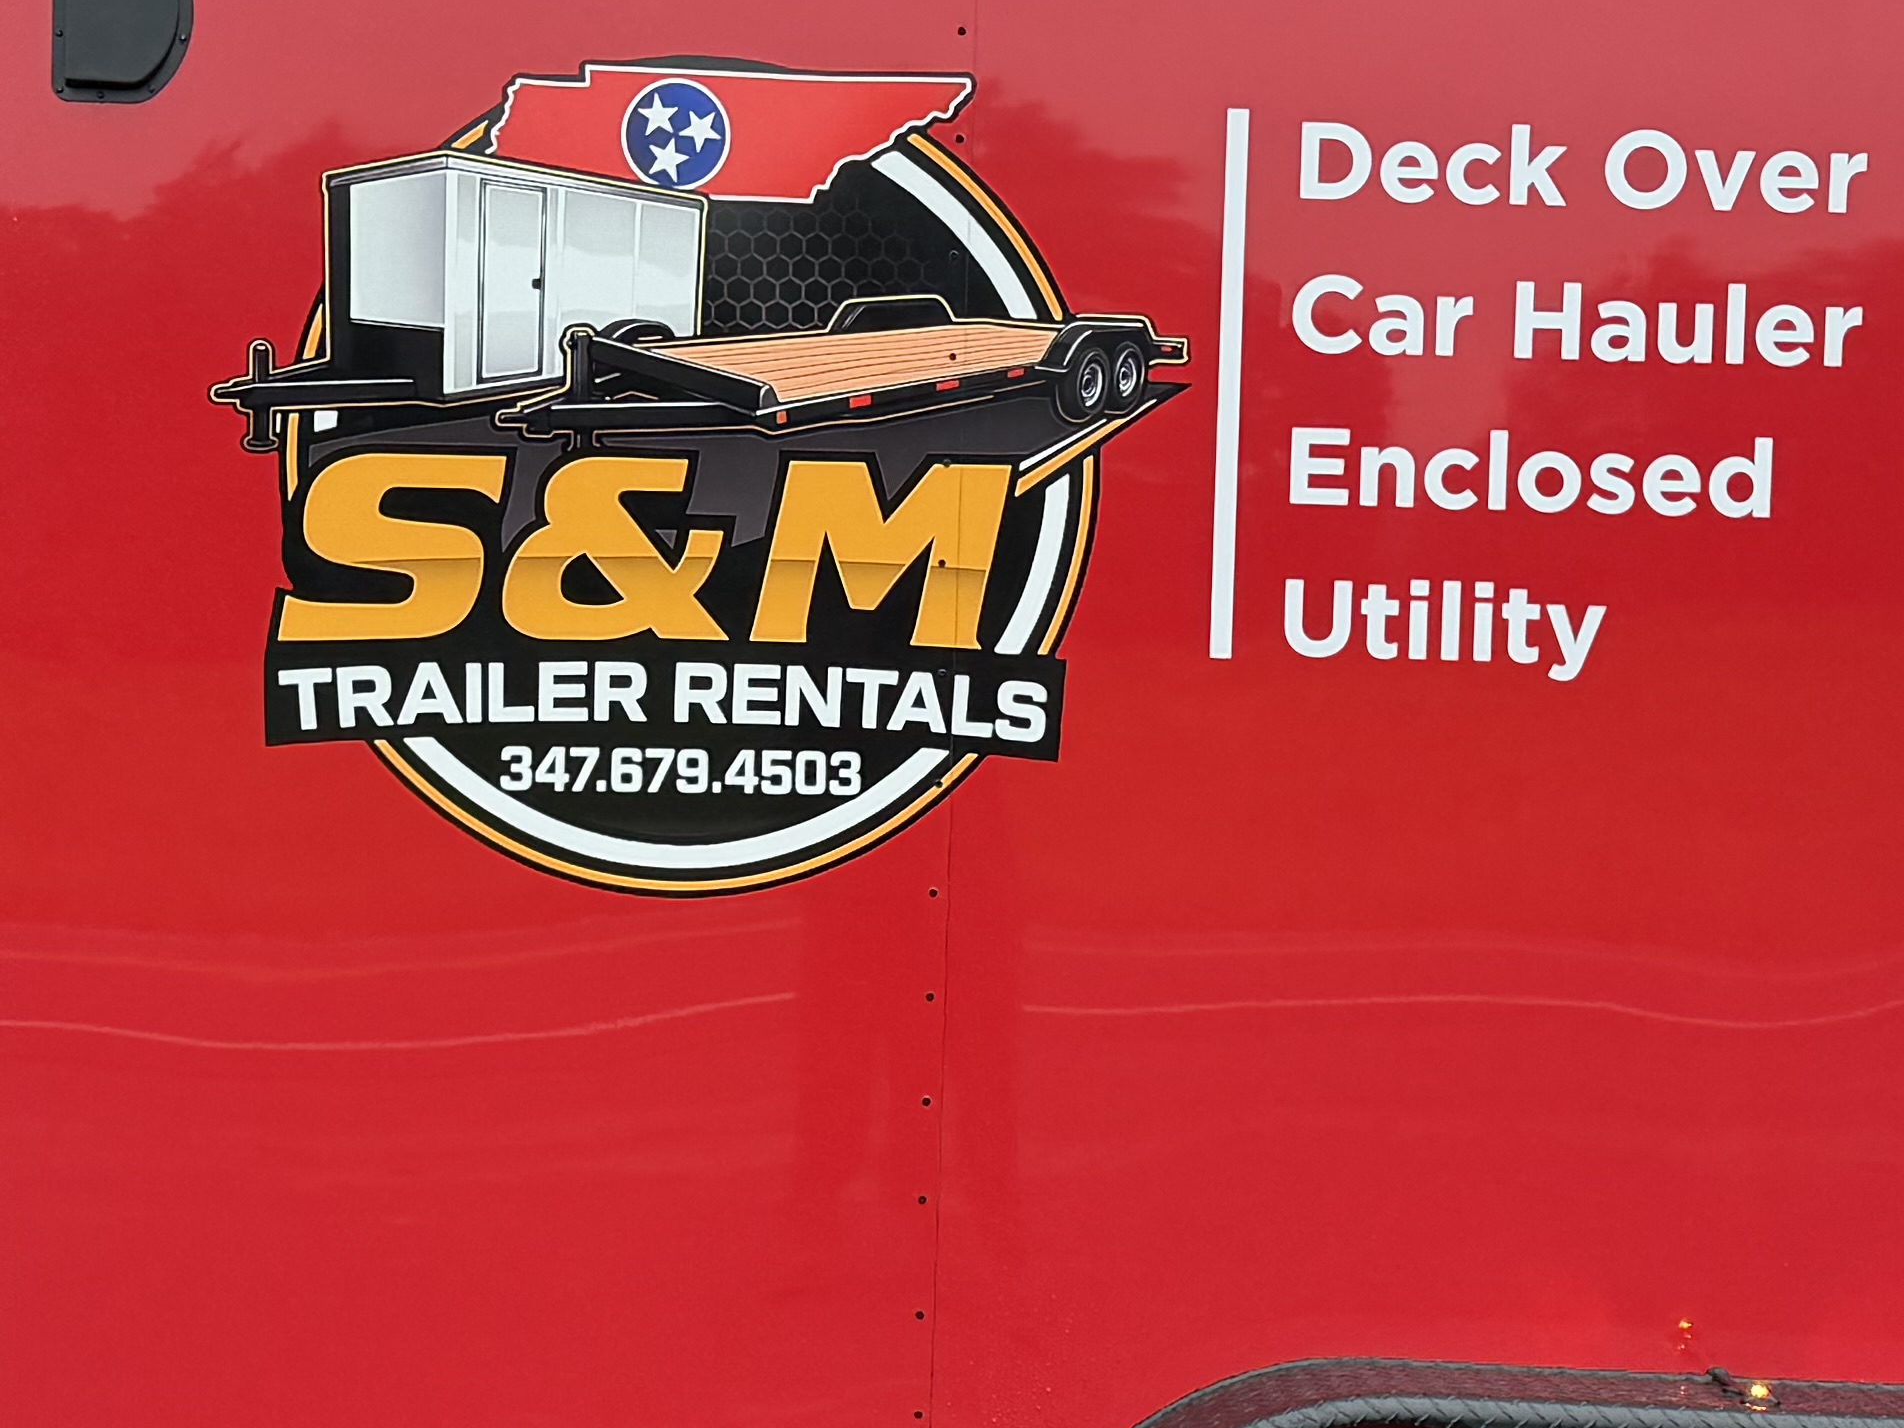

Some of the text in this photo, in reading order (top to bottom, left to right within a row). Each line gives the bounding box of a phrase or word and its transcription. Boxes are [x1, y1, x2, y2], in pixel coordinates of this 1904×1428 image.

[1299, 121, 1869, 214] Deck Over
[1292, 274, 1863, 367] Car Hauler
[1289, 427, 1774, 519] Enclosed
[278, 453, 1012, 649] S&M
[1284, 578, 1607, 682] Utility
[278, 660, 1047, 744] TRAILER RENTALS
[499, 745, 862, 798] 347.679.4503
